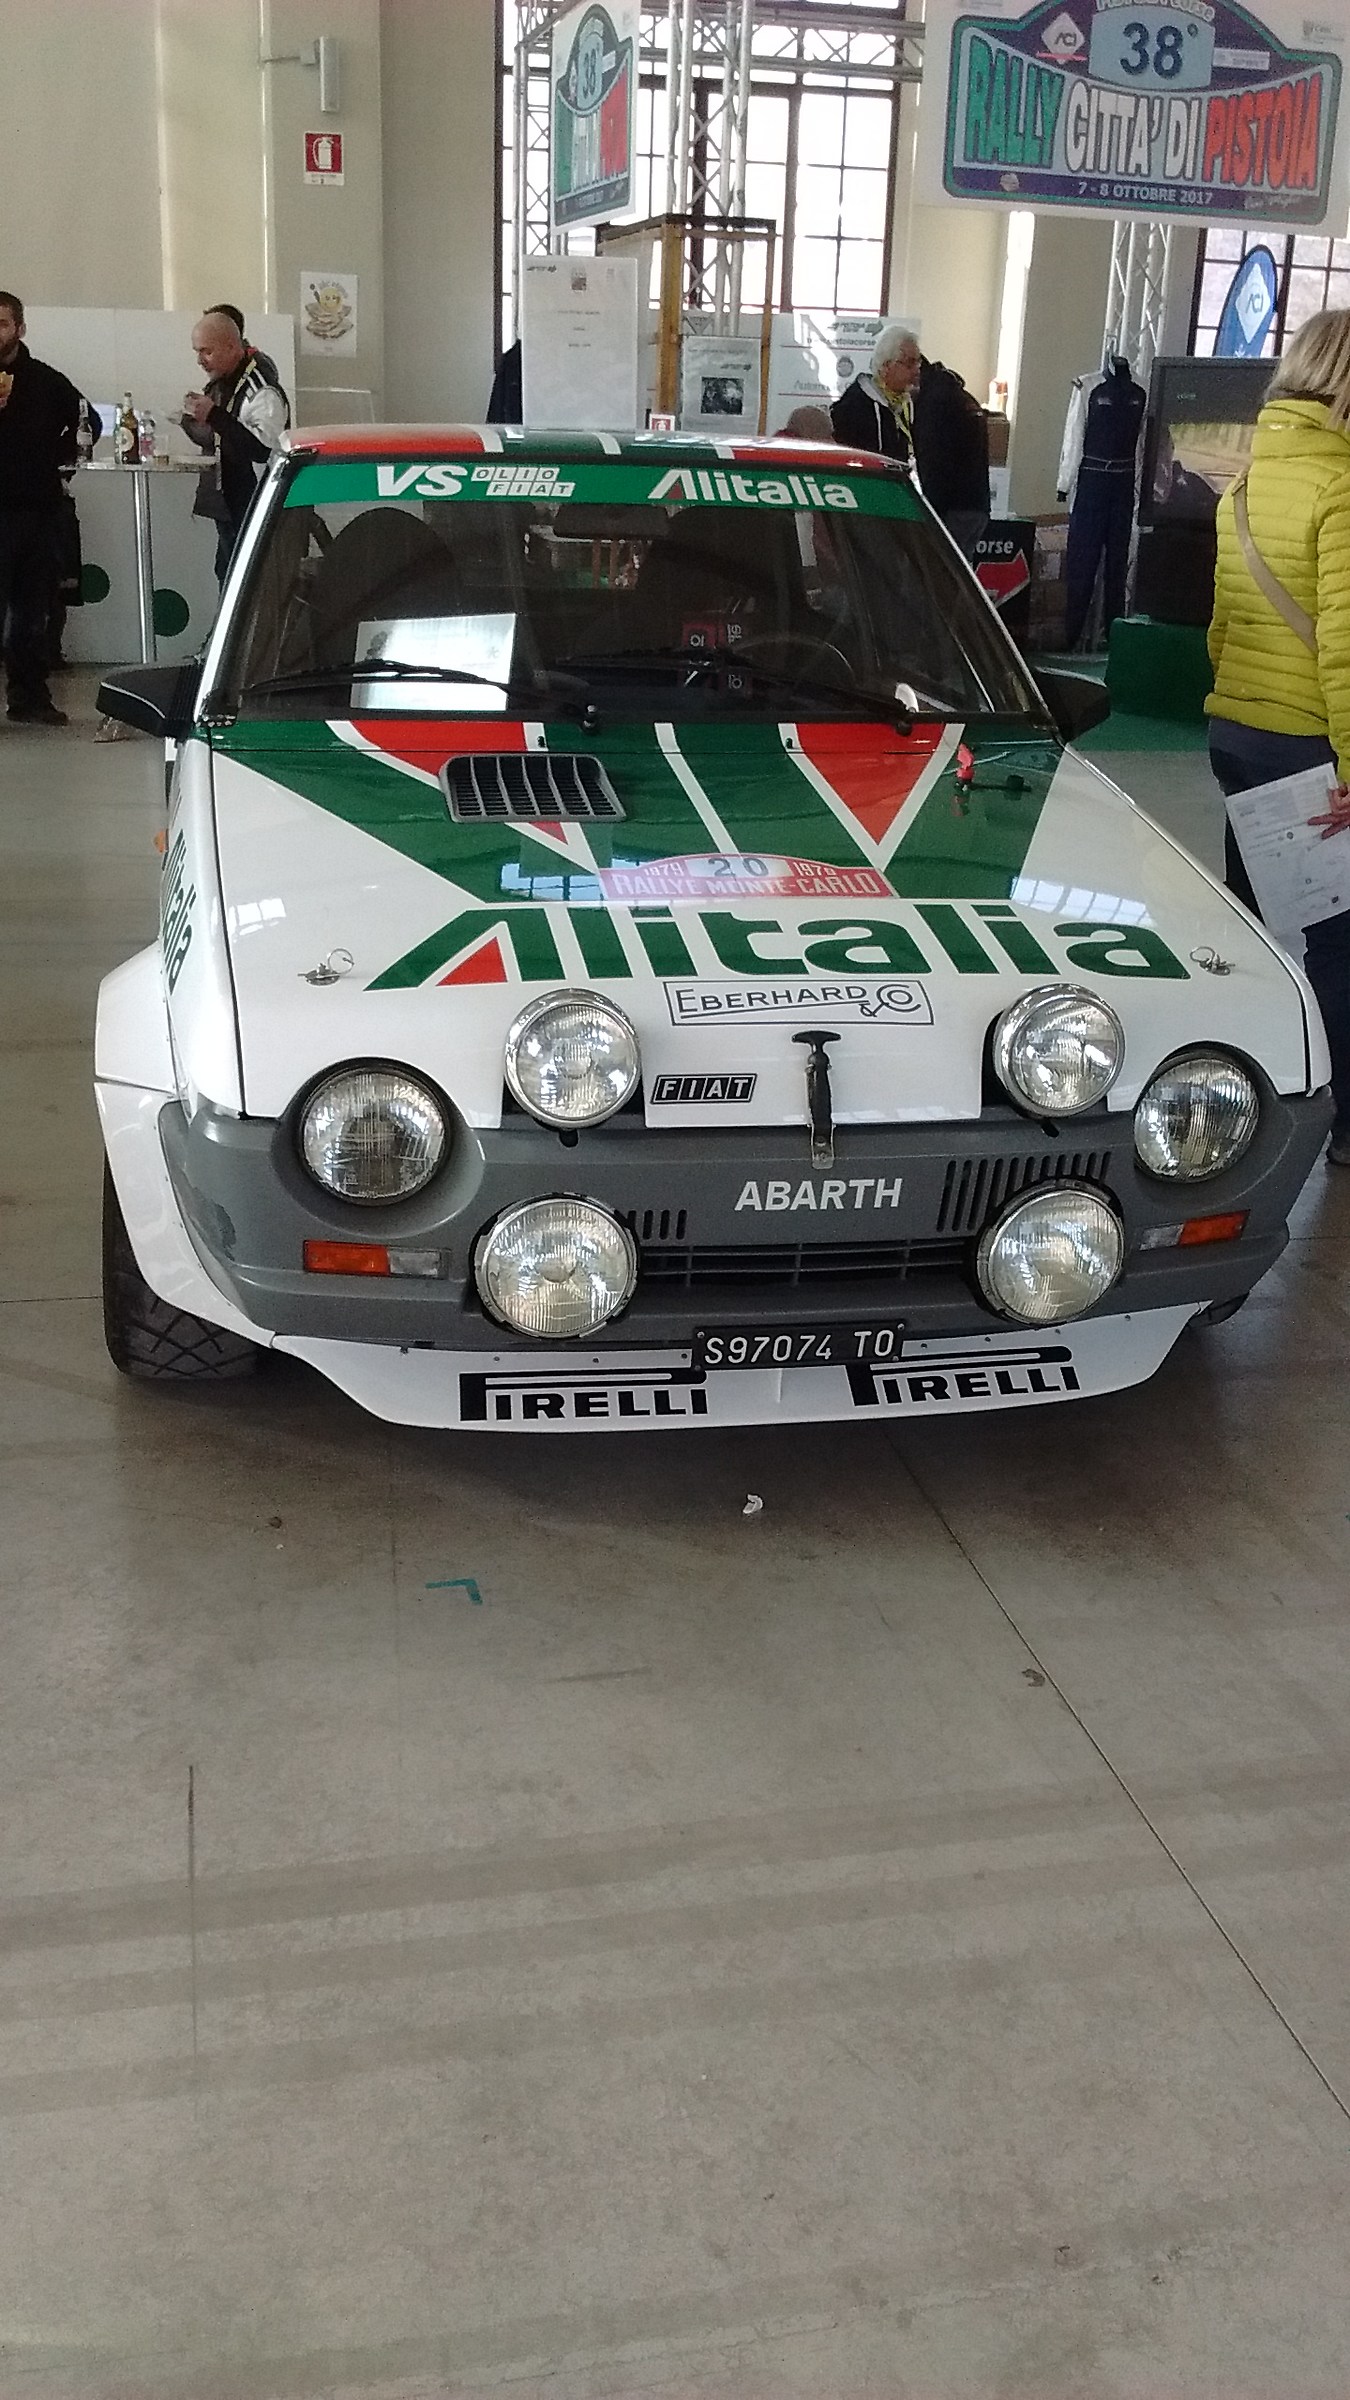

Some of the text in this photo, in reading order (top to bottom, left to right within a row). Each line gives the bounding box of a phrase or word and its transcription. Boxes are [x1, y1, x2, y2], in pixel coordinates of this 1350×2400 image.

[964, 35, 1324, 190] RALLY CITTA' DI PISTOIA
[1079, 182, 1087, 194] 7
[1099, 183, 1109, 197] 8
[1112, 185, 1176, 202] OTTOBRE
[1180, 190, 1214, 205] 2017
[376, 465, 469, 497] VS
[475, 468, 555, 480] OLIO
[491, 483, 570, 495] FIAT
[647, 468, 859, 508] Alitalia
[612, 872, 882, 896] RALLYE MONTE-CARLO
[708, 858, 771, 878] 20
[363, 903, 1192, 991] Alitalia
[675, 985, 868, 1013] EBERHARD
[660, 1079, 750, 1099] FIAT
[734, 1178, 902, 1212] ABARTH
[704, 1330, 894, 1364] S97074 TO
[845, 1345, 1081, 1407] PIRELLI
[459, 1367, 709, 1421] PIRELLI
